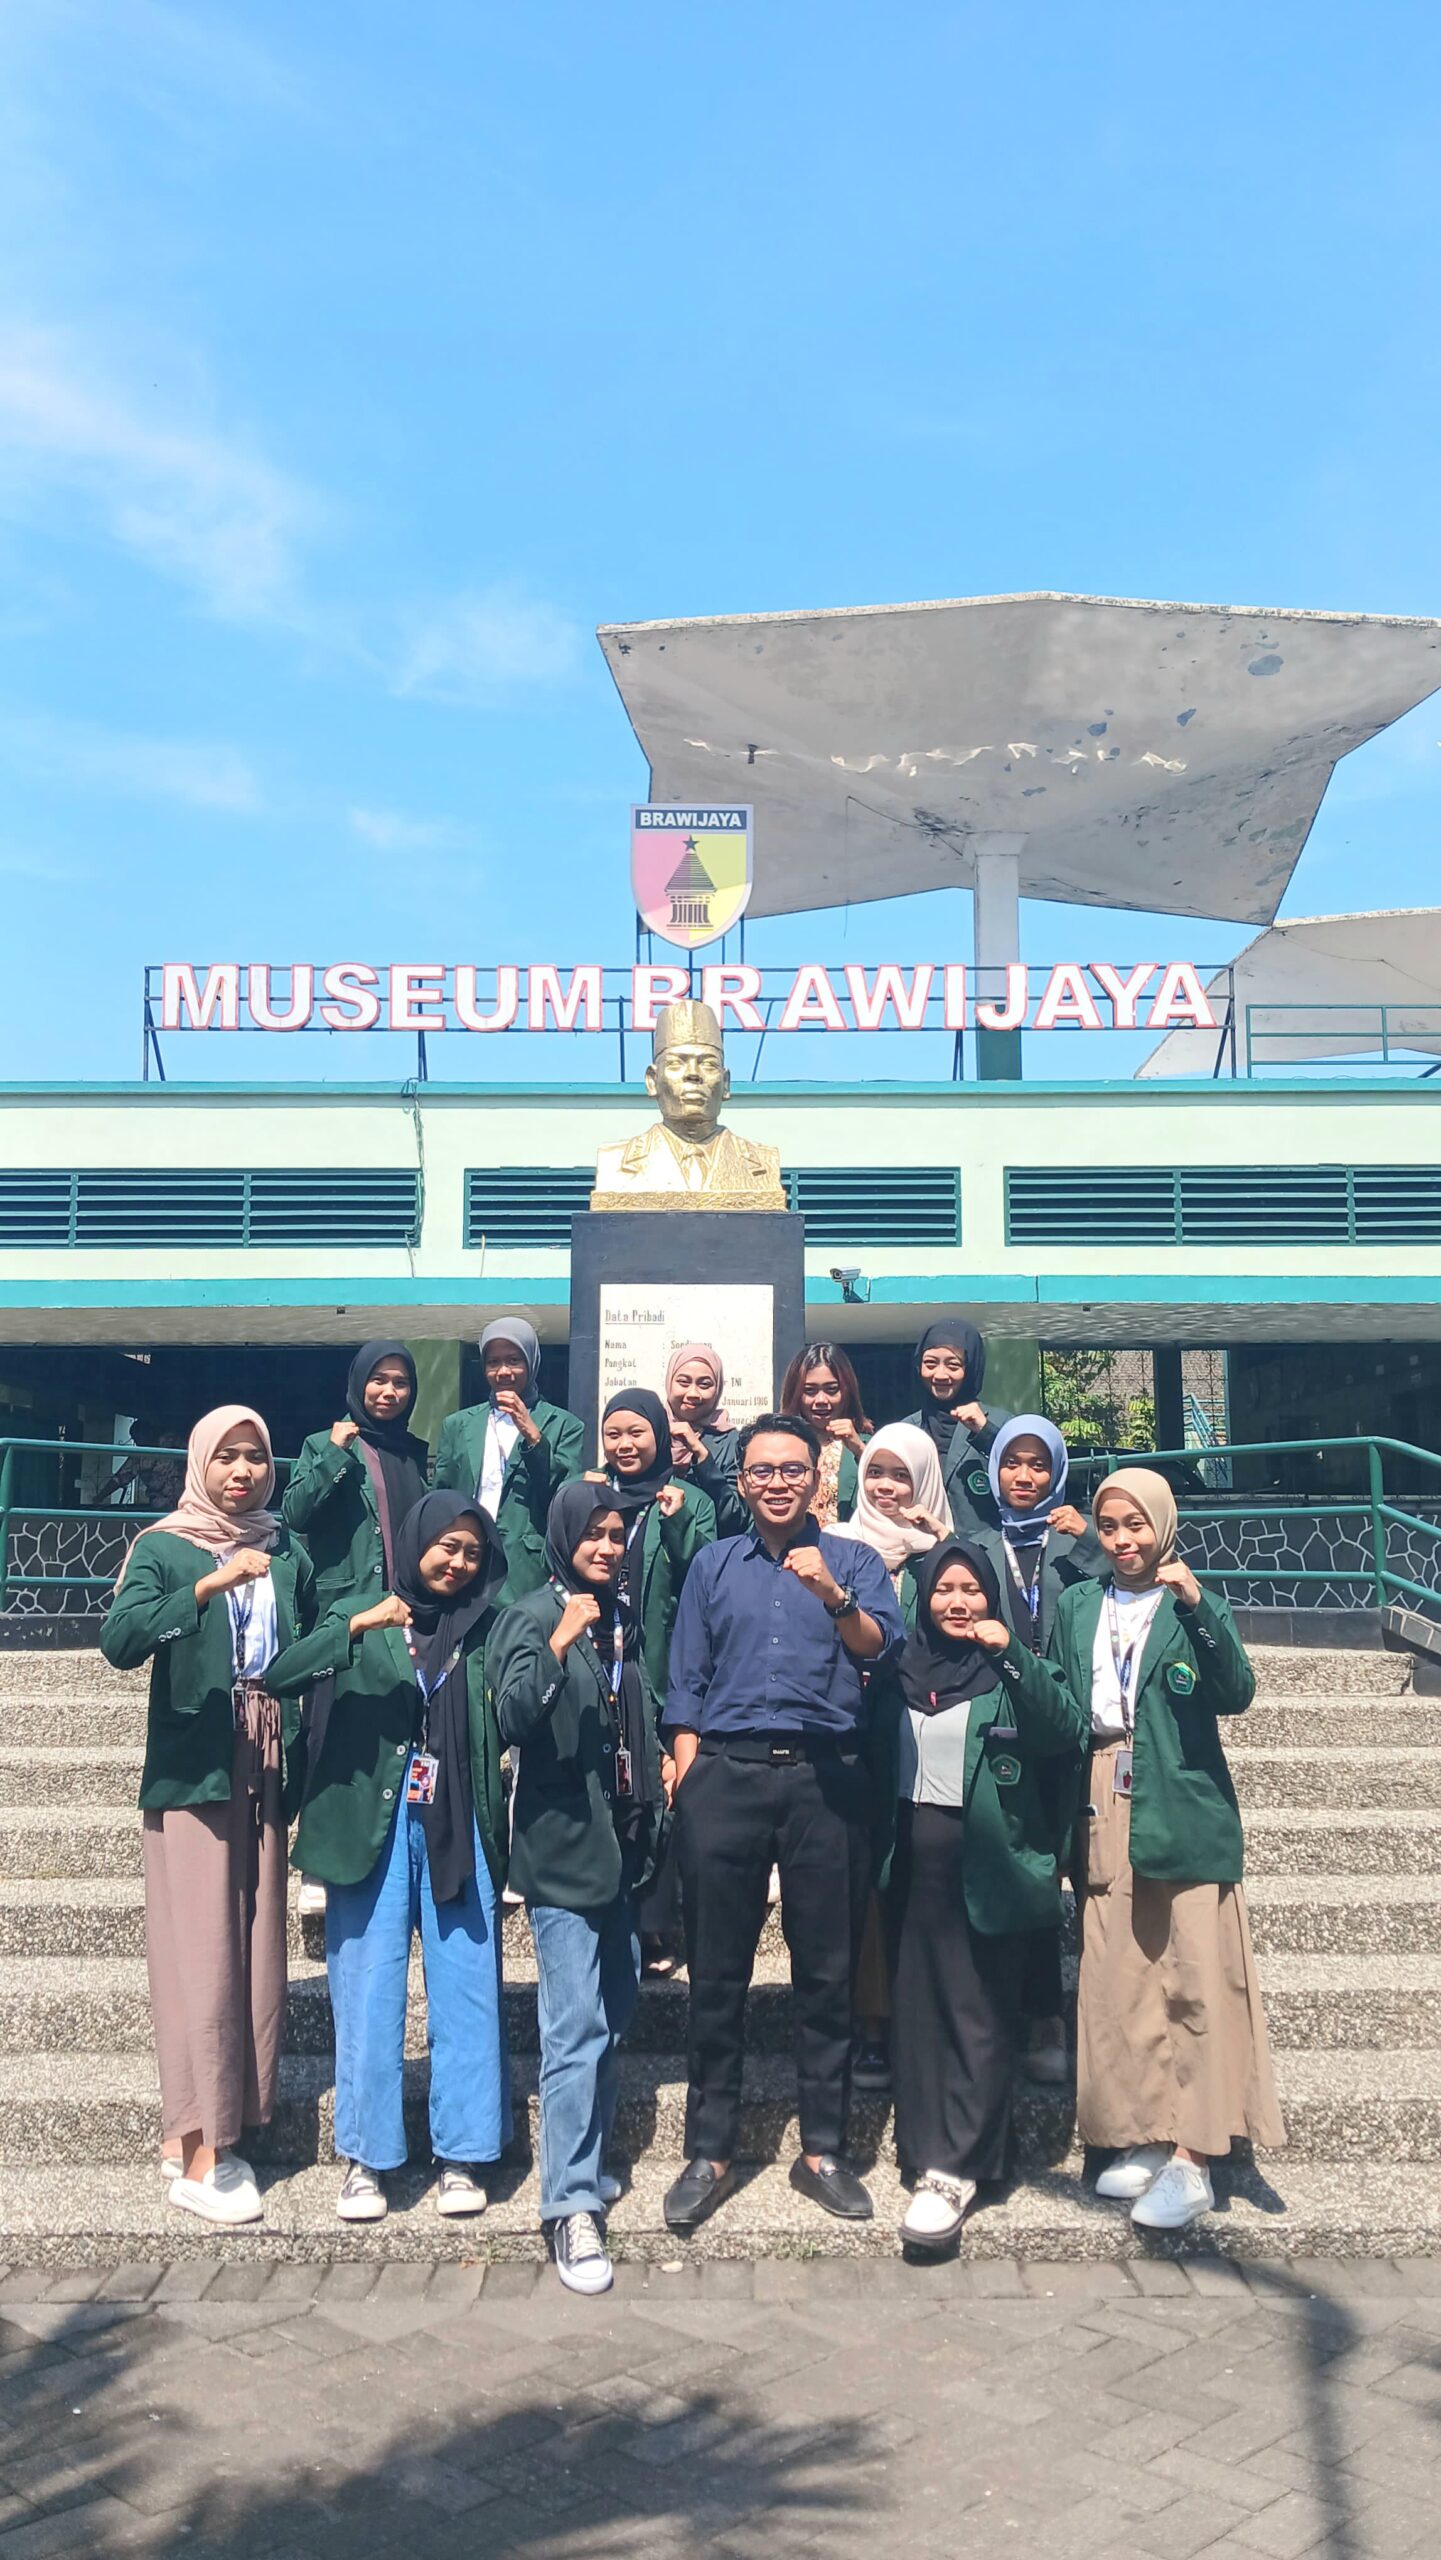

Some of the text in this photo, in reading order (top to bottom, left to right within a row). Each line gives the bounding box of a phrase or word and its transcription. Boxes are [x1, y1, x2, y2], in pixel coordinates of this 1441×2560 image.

[640, 812, 742, 827] BRAWIJAYA
[162, 962, 1217, 1032] MUSEUM BRAWIJAYA
[605, 1309, 665, 1322] Data Pribadi
[604, 1339, 627, 1349] Nama
[604, 1358, 637, 1371] Pangkat
[604, 1377, 638, 1387] Jabatan
[731, 1377, 742, 1388] TNI
[722, 1396, 752, 1406] Januari
